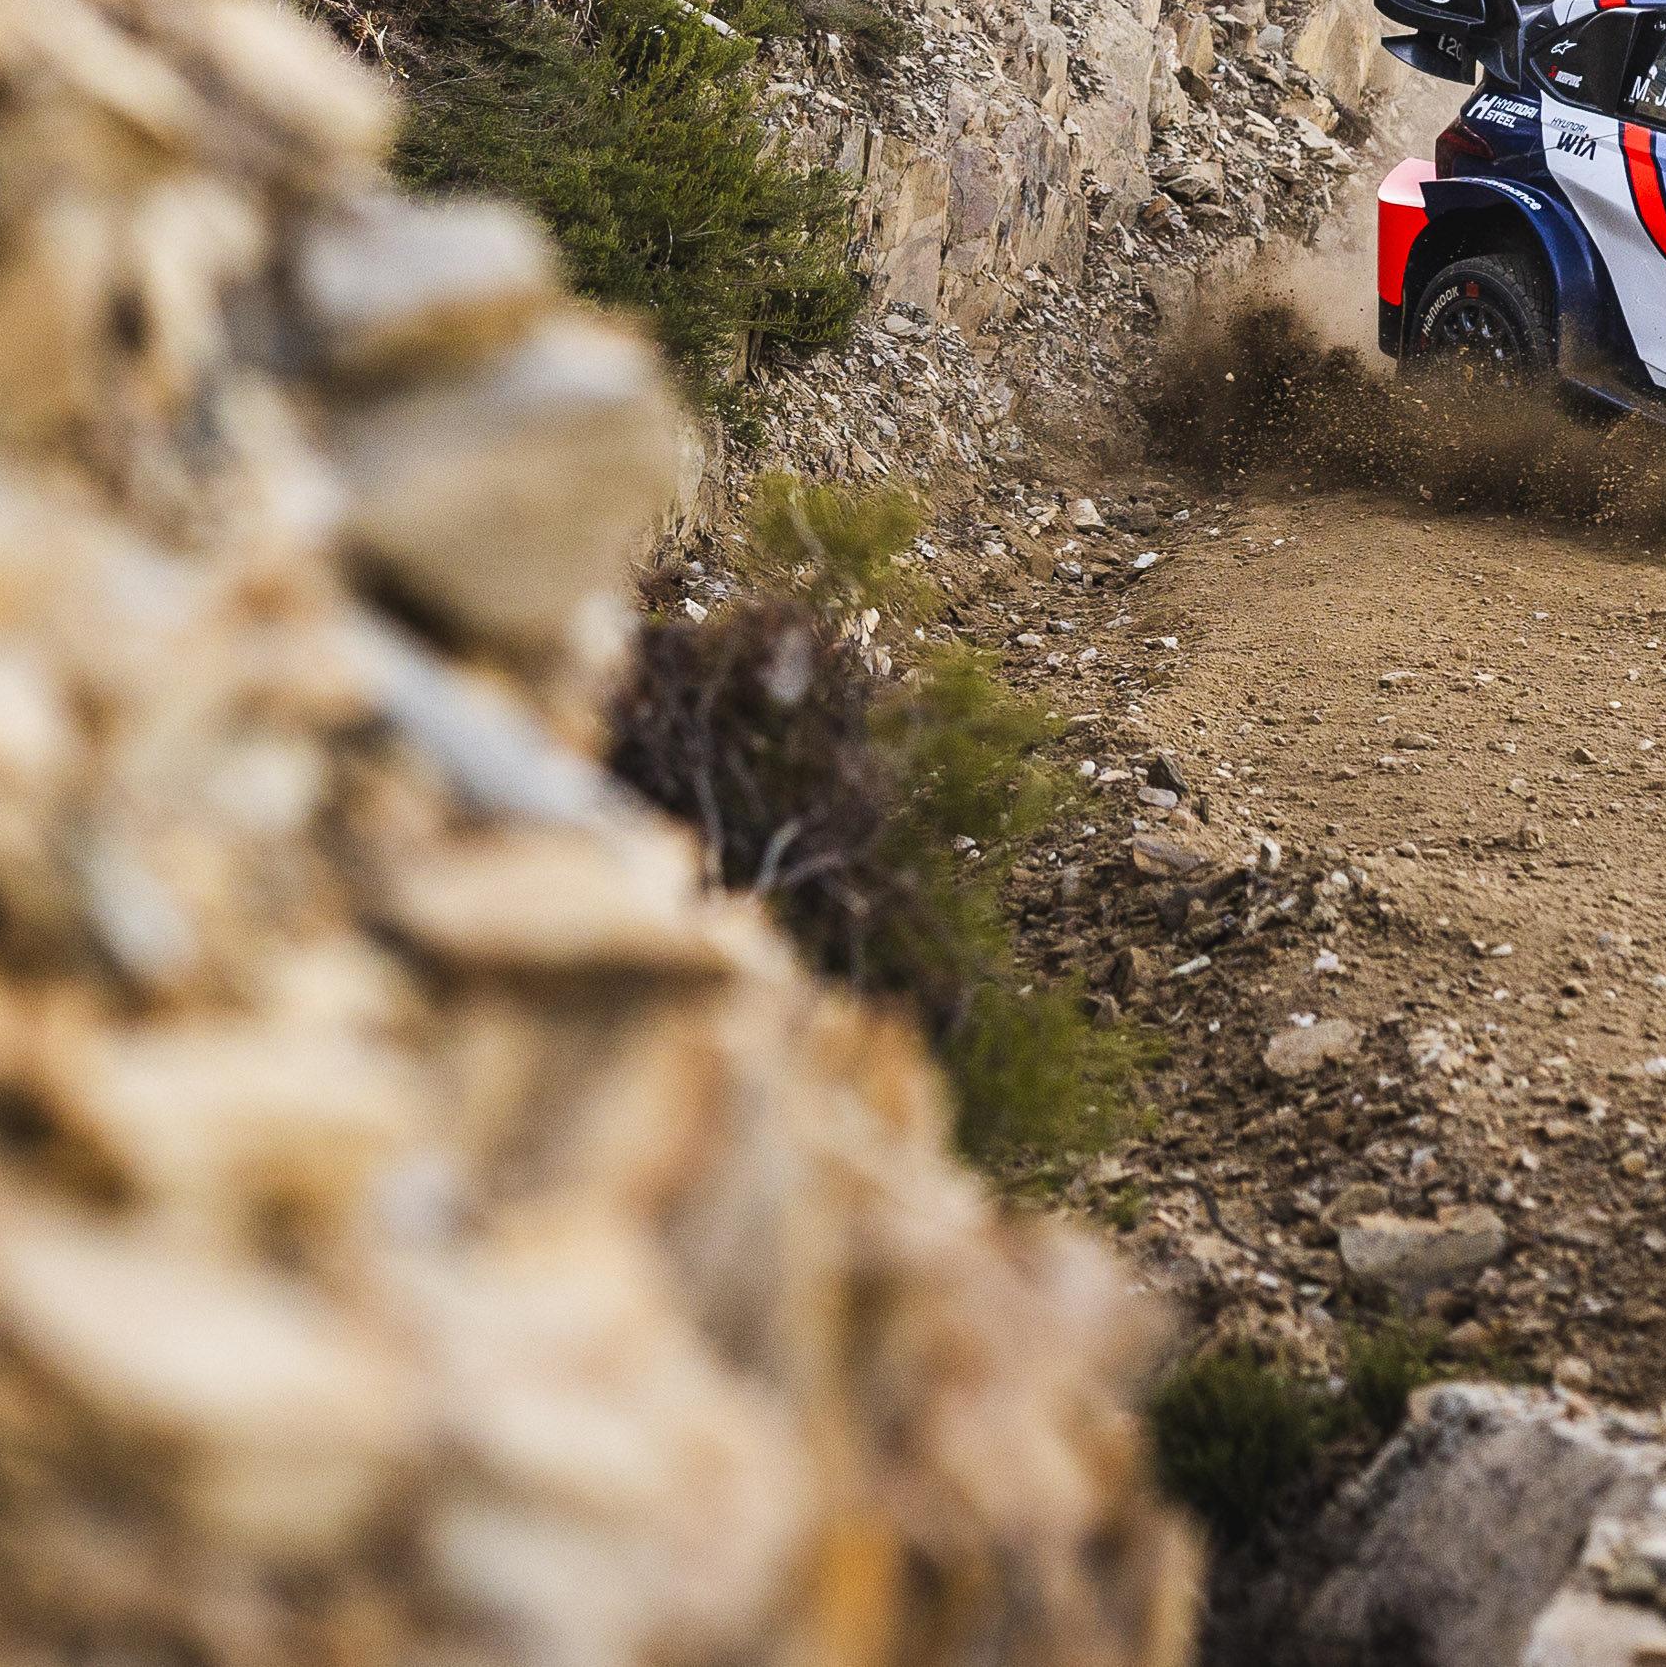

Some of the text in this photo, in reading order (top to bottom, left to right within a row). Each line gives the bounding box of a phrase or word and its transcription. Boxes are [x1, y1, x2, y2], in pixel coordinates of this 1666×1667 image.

[1631, 76, 1651, 103] M.
[1484, 109, 1517, 129] STEEL
[1494, 95, 1539, 119] HYUNDAI
[1551, 116, 1589, 134] HYUNDAI
[1556, 131, 1597, 161] WIA
